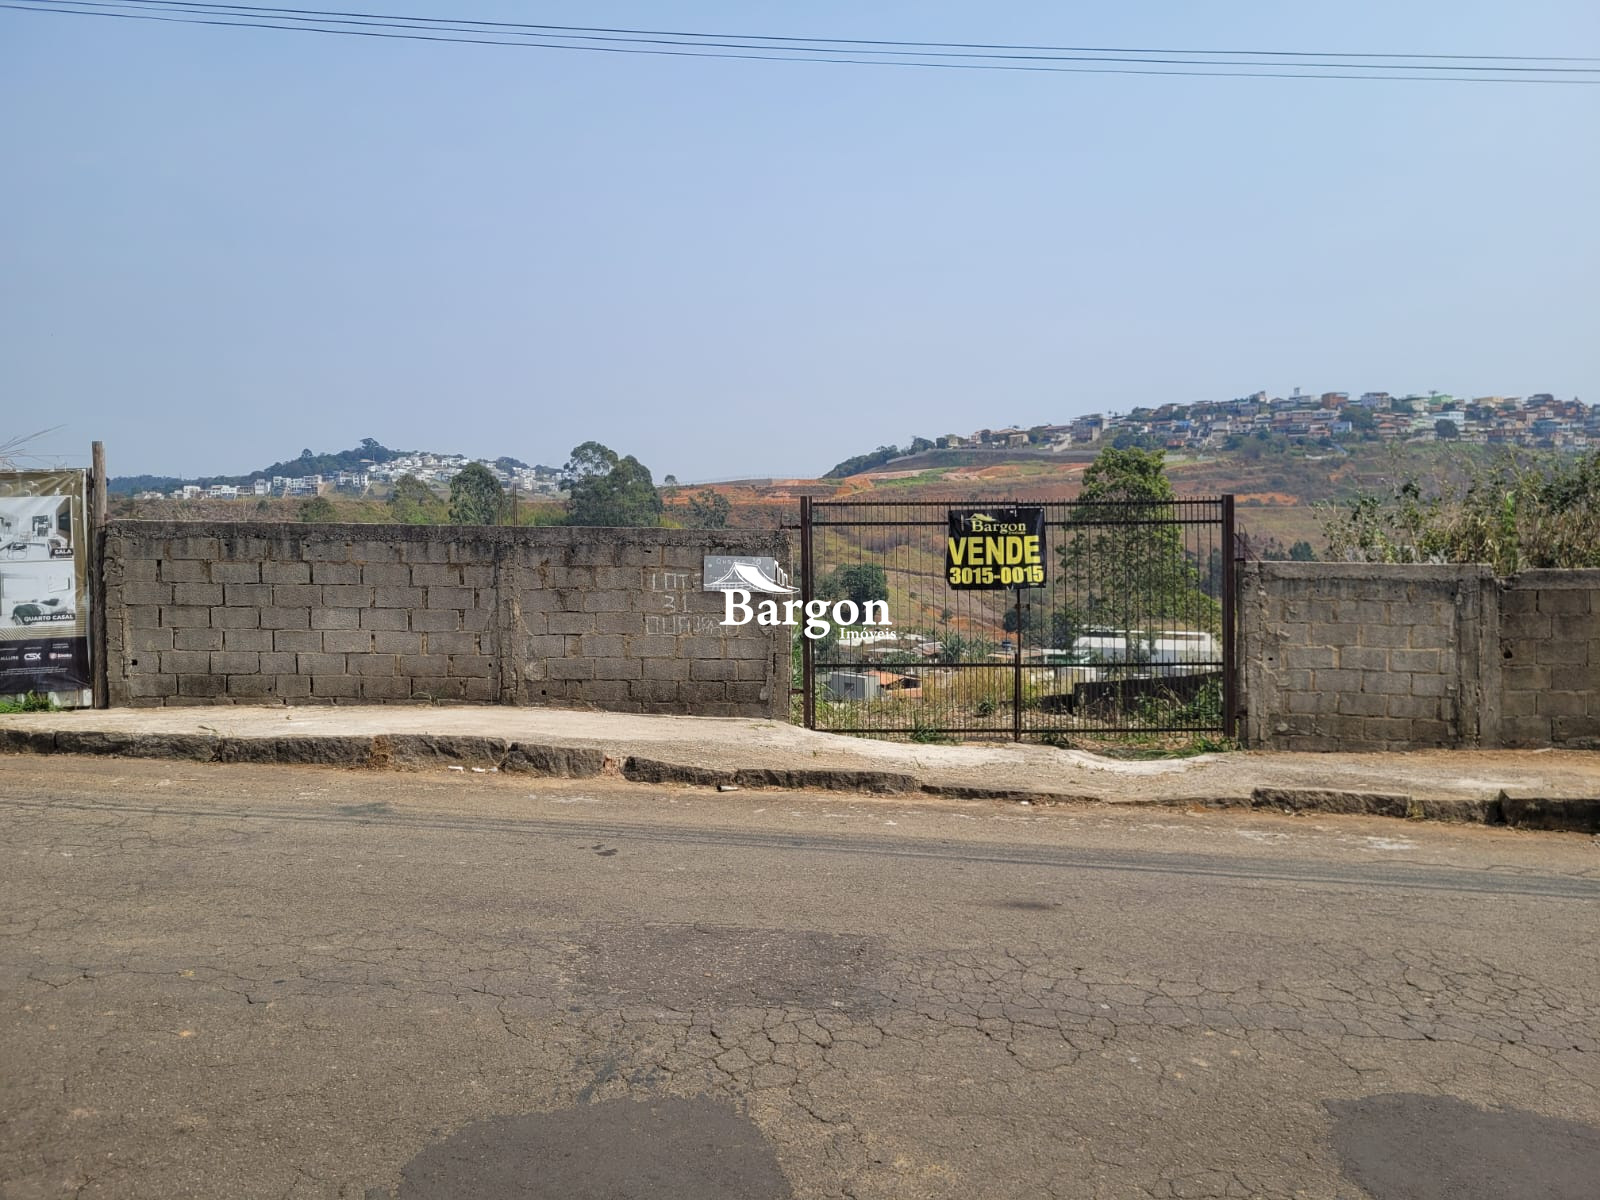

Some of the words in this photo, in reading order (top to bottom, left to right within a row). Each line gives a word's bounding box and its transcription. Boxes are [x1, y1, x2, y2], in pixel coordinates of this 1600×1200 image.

[971, 520, 1026, 534] Bargon
[948, 535, 1041, 565] VENDE
[949, 565, 1044, 585] 3015-0015
